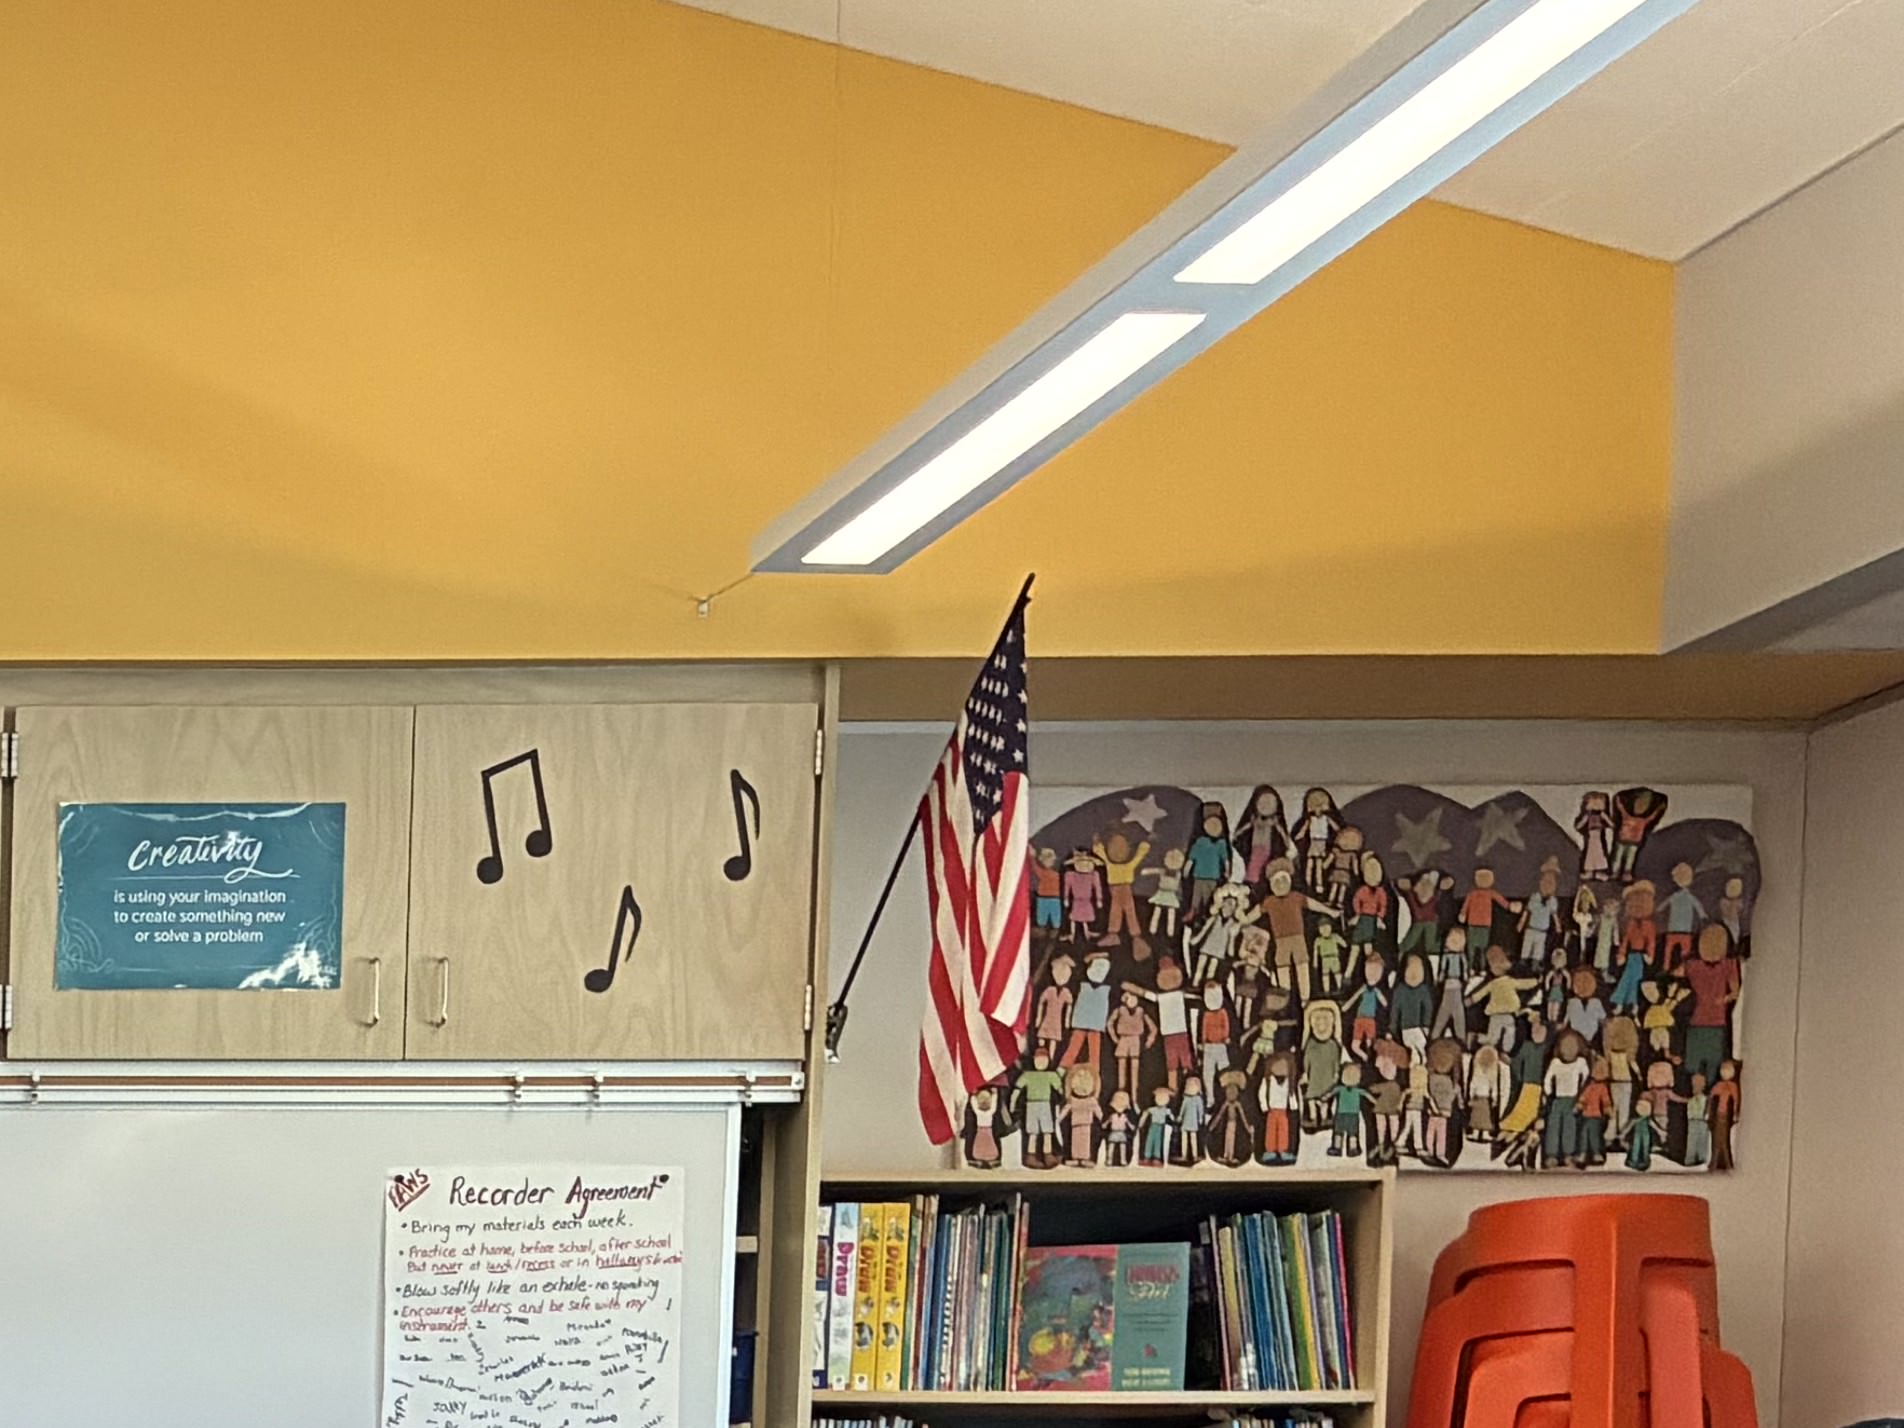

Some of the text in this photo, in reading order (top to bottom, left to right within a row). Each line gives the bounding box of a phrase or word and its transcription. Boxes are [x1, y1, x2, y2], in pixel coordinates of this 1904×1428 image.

[128, 834, 293, 884] Creativity
[114, 890, 286, 906] is using your imagination
[114, 910, 285, 926] to create something new
[135, 930, 263, 943] or solve a problem
[450, 1175, 555, 1207] Recorder
[565, 1175, 662, 1220] Agreement
[411, 1220, 450, 1243] Bring
[456, 1222, 476, 1236] my
[483, 1215, 545, 1232] materials
[835, 1242, 855, 1296] Draw
